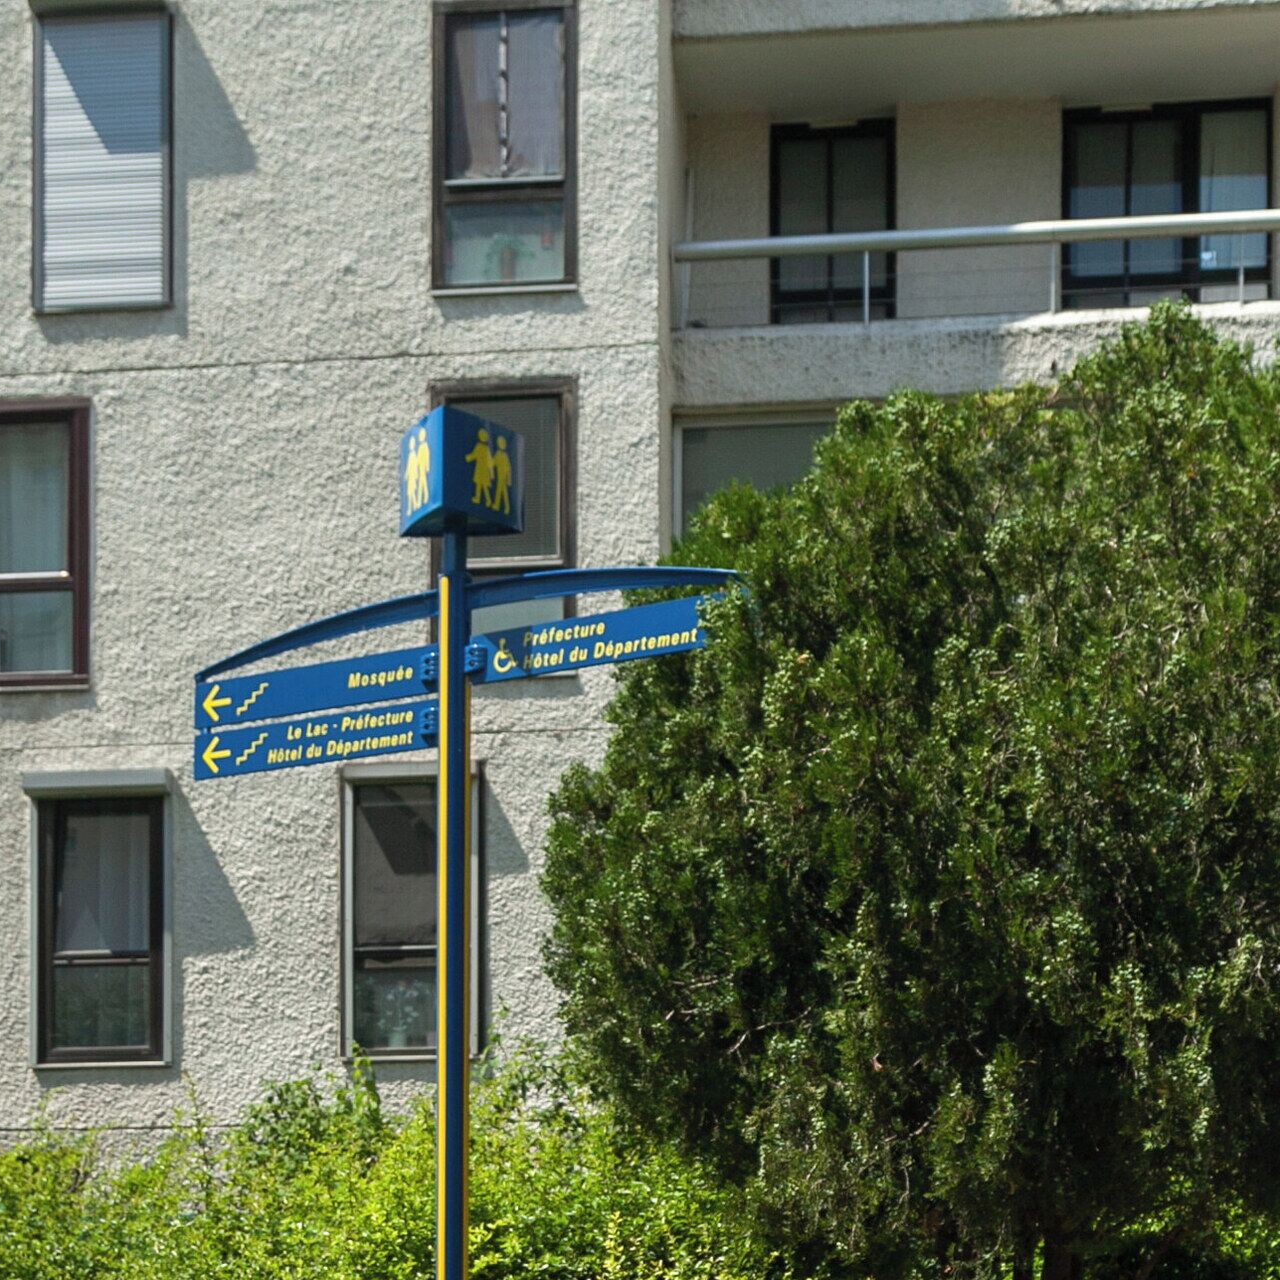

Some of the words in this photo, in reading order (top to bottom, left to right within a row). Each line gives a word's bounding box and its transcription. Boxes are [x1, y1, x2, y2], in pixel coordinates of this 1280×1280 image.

[523, 622, 605, 647] Préfecture
[523, 649, 564, 670] Hôtel
[569, 646, 588, 663] du
[593, 628, 698, 659] Département
[348, 664, 414, 689] Mosquée
[287, 725, 302, 741] Le
[306, 722, 328, 738] Lac
[341, 710, 414, 733] Préfecture
[267, 745, 302, 764] Hôtel
[306, 743, 322, 759] du
[326, 730, 414, 757] Département
